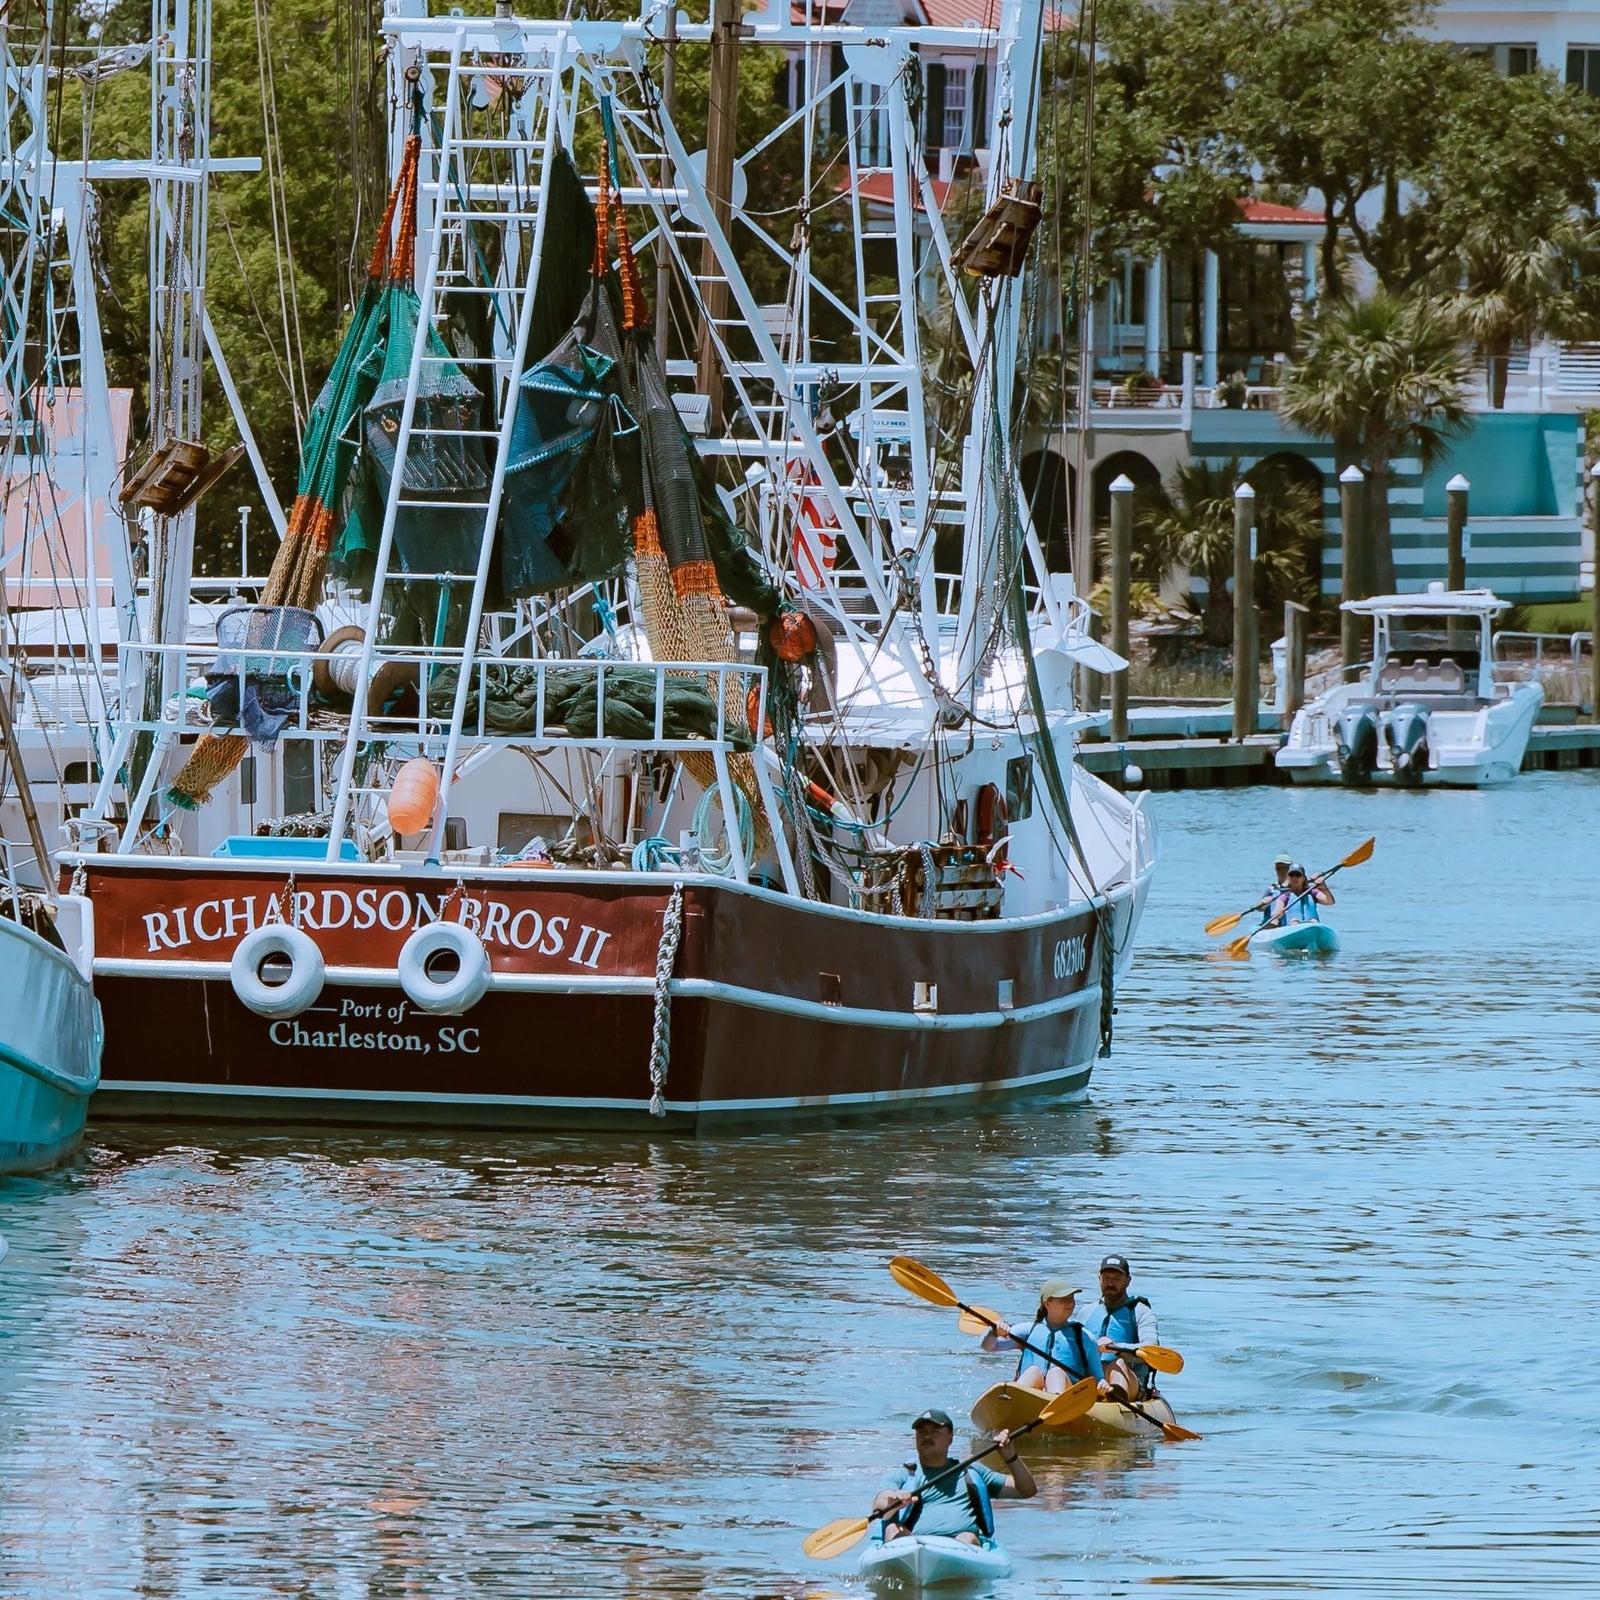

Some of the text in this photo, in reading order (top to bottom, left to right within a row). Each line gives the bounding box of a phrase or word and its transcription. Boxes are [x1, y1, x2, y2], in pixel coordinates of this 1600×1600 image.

[142, 888, 612, 969] RICHARDSON BROS II
[1053, 933, 1087, 980] 682306
[340, 999, 409, 1025] Port of
[269, 1020, 480, 1055] Charleston, SC
